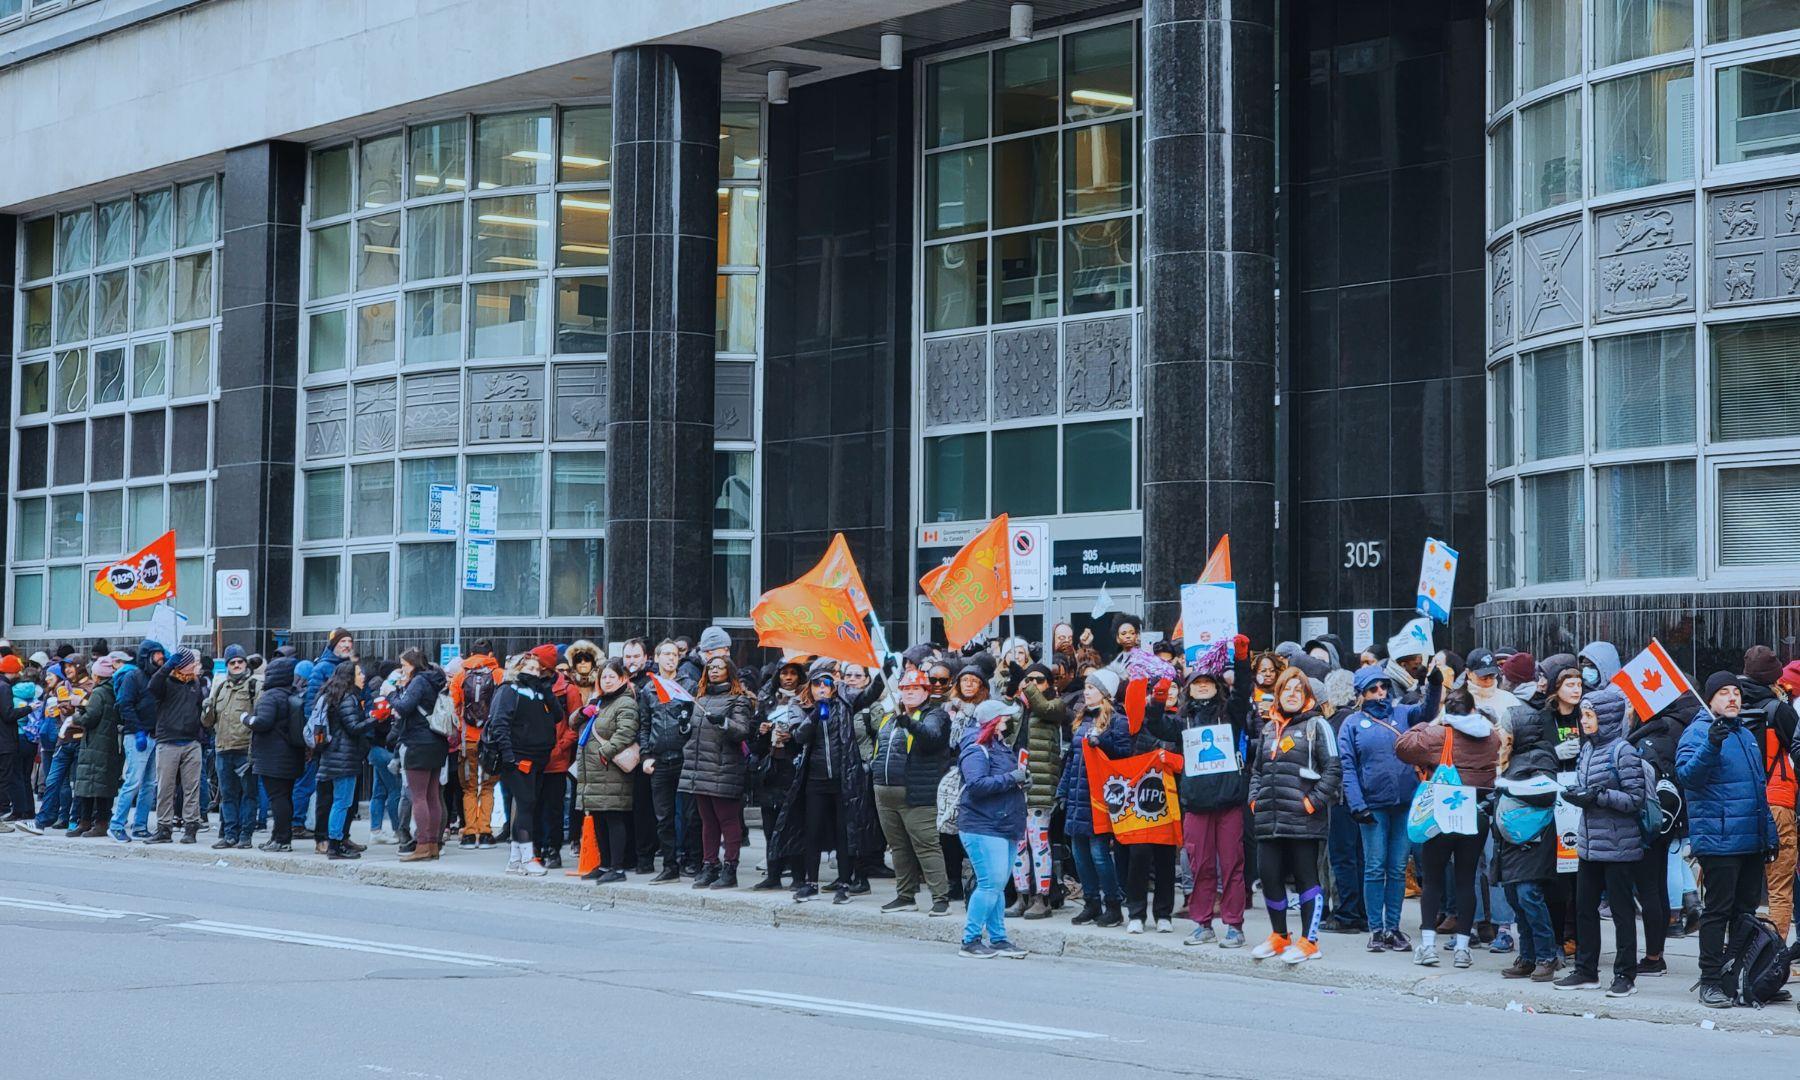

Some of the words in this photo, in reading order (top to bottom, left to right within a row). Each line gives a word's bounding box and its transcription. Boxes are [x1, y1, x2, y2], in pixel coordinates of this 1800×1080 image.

[1082, 550, 1098, 561] 305
[1344, 542, 1380, 568] 305
[1082, 561, 1143, 576] René-Lévesqu
[1194, 762, 1208, 771] ALL
[1139, 788, 1166, 804] AFPC
